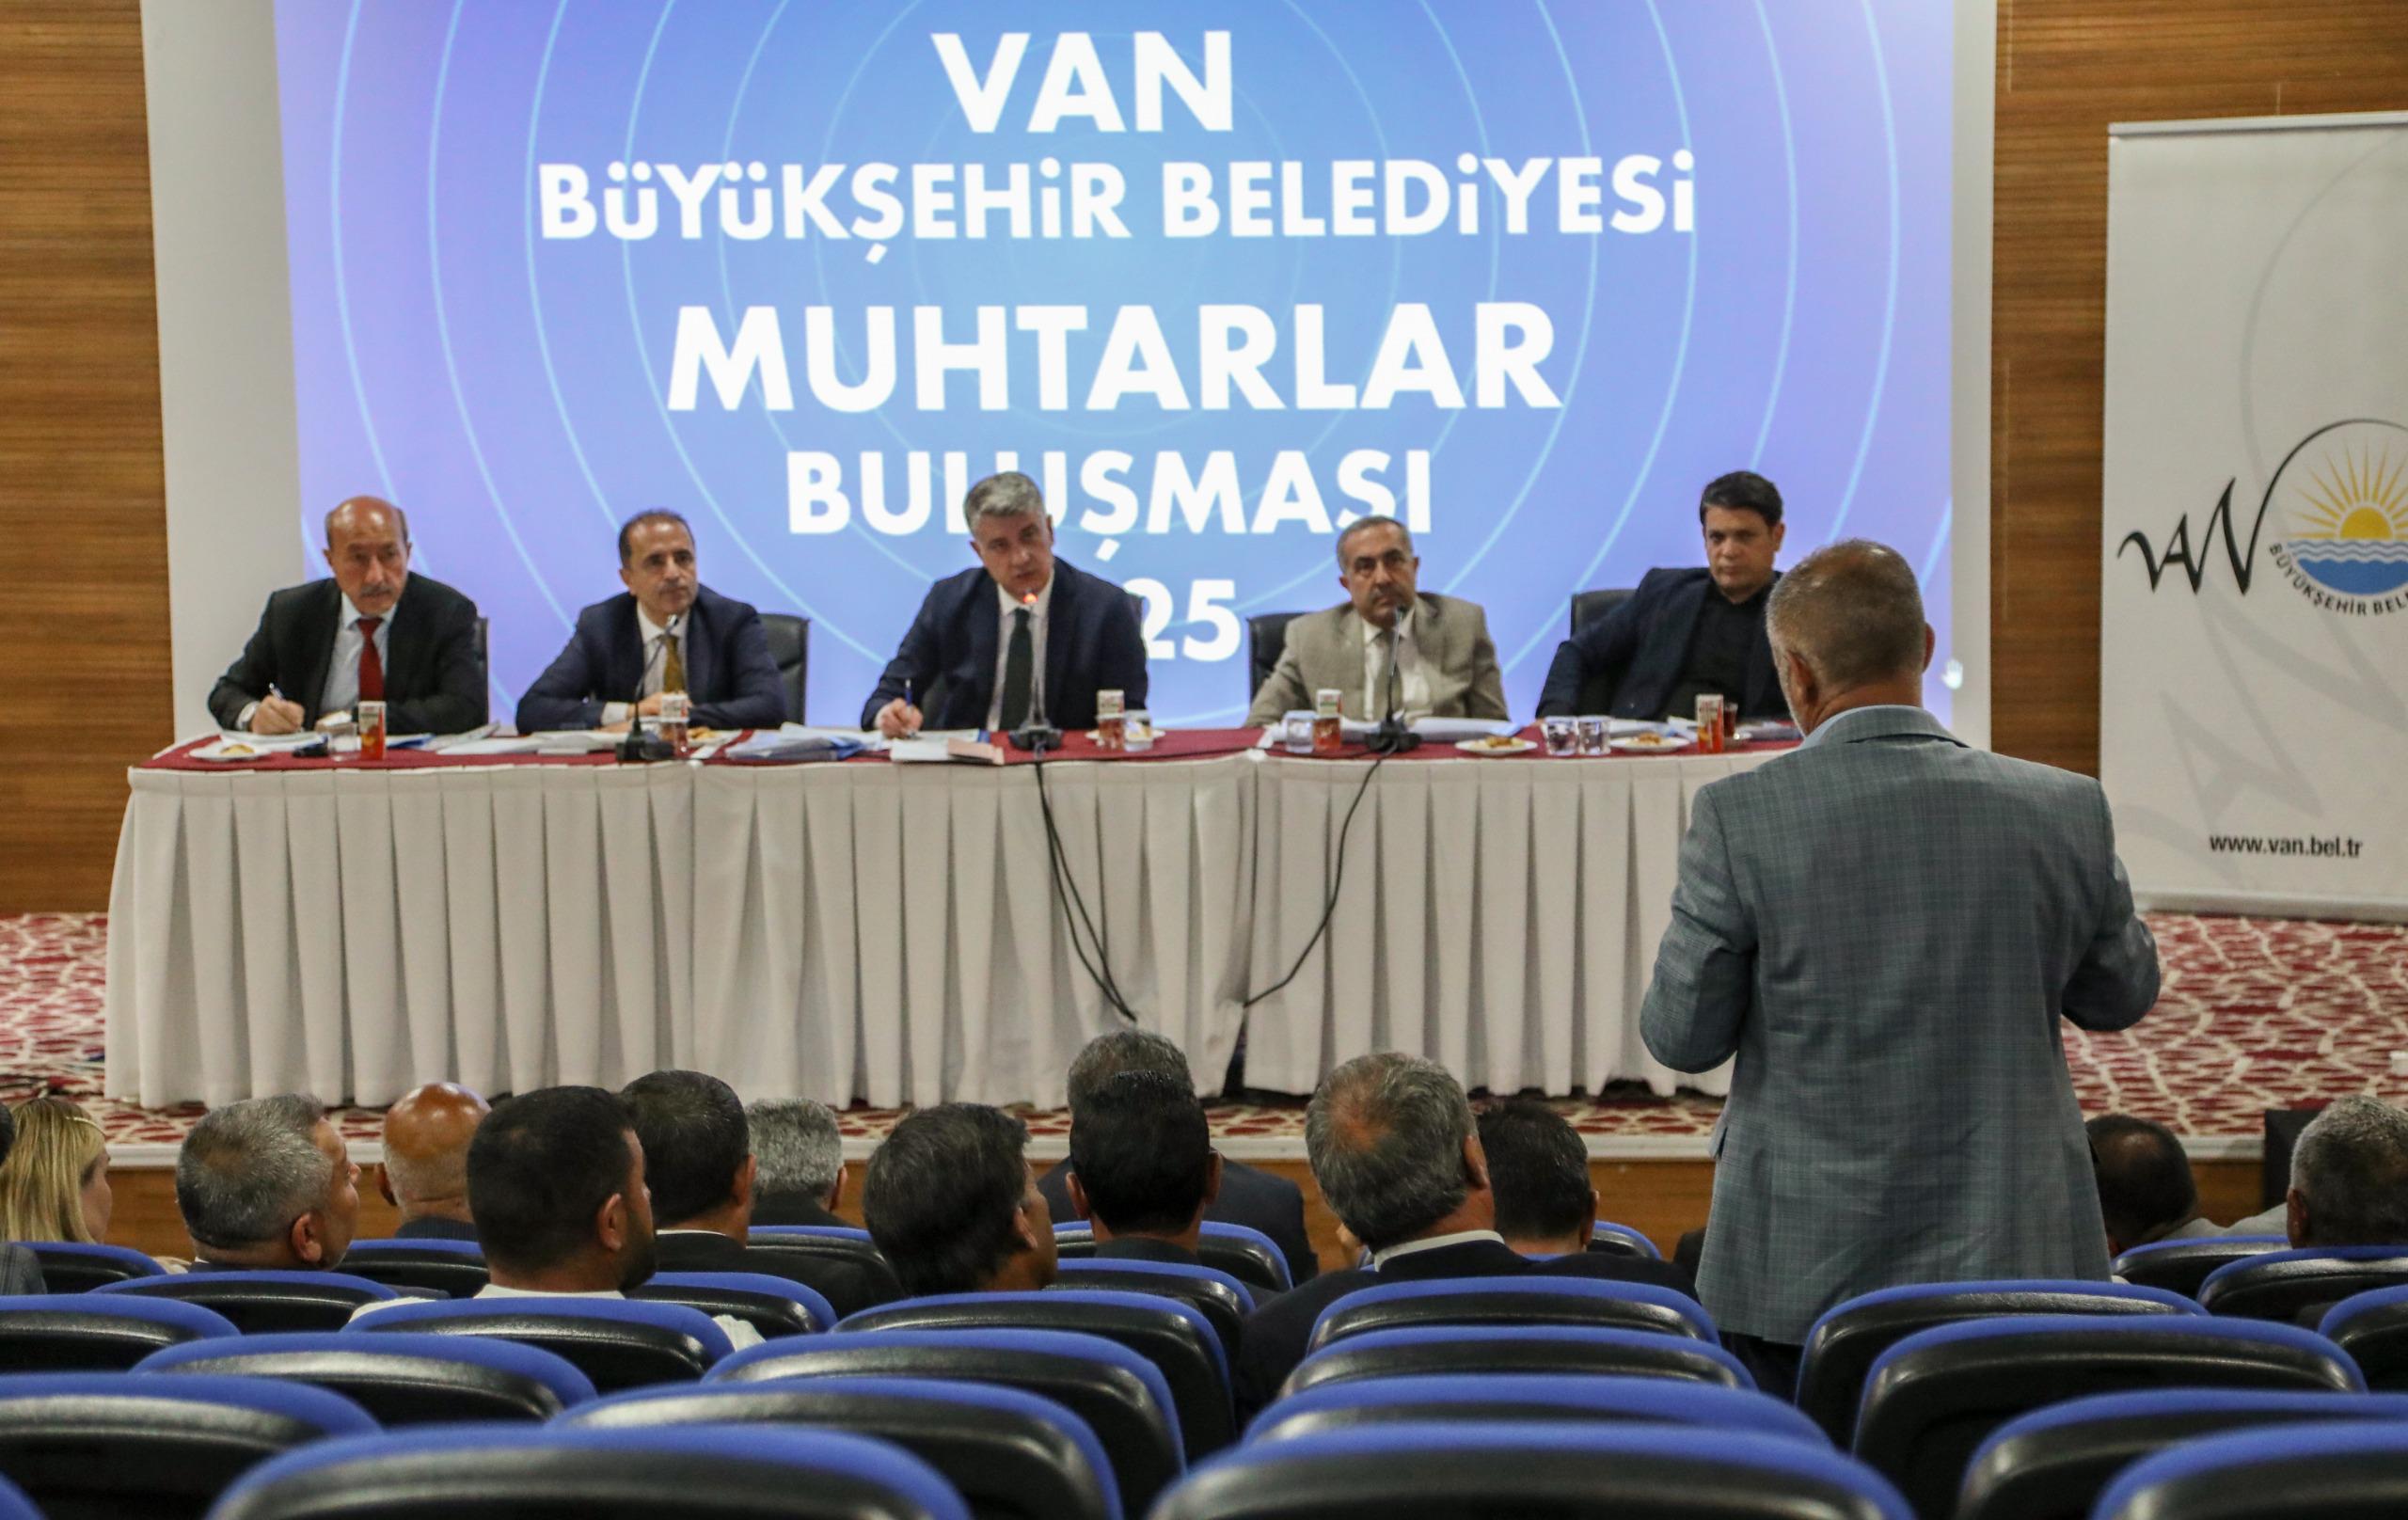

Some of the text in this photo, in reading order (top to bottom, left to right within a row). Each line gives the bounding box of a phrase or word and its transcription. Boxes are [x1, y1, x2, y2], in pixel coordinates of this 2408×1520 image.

[931, 31, 1233, 134] VAN
[667, 302, 1562, 412] MUHTARLAR
[2117, 444, 2300, 595] VAN
[2209, 835, 2363, 859] www.van.bel.tr
